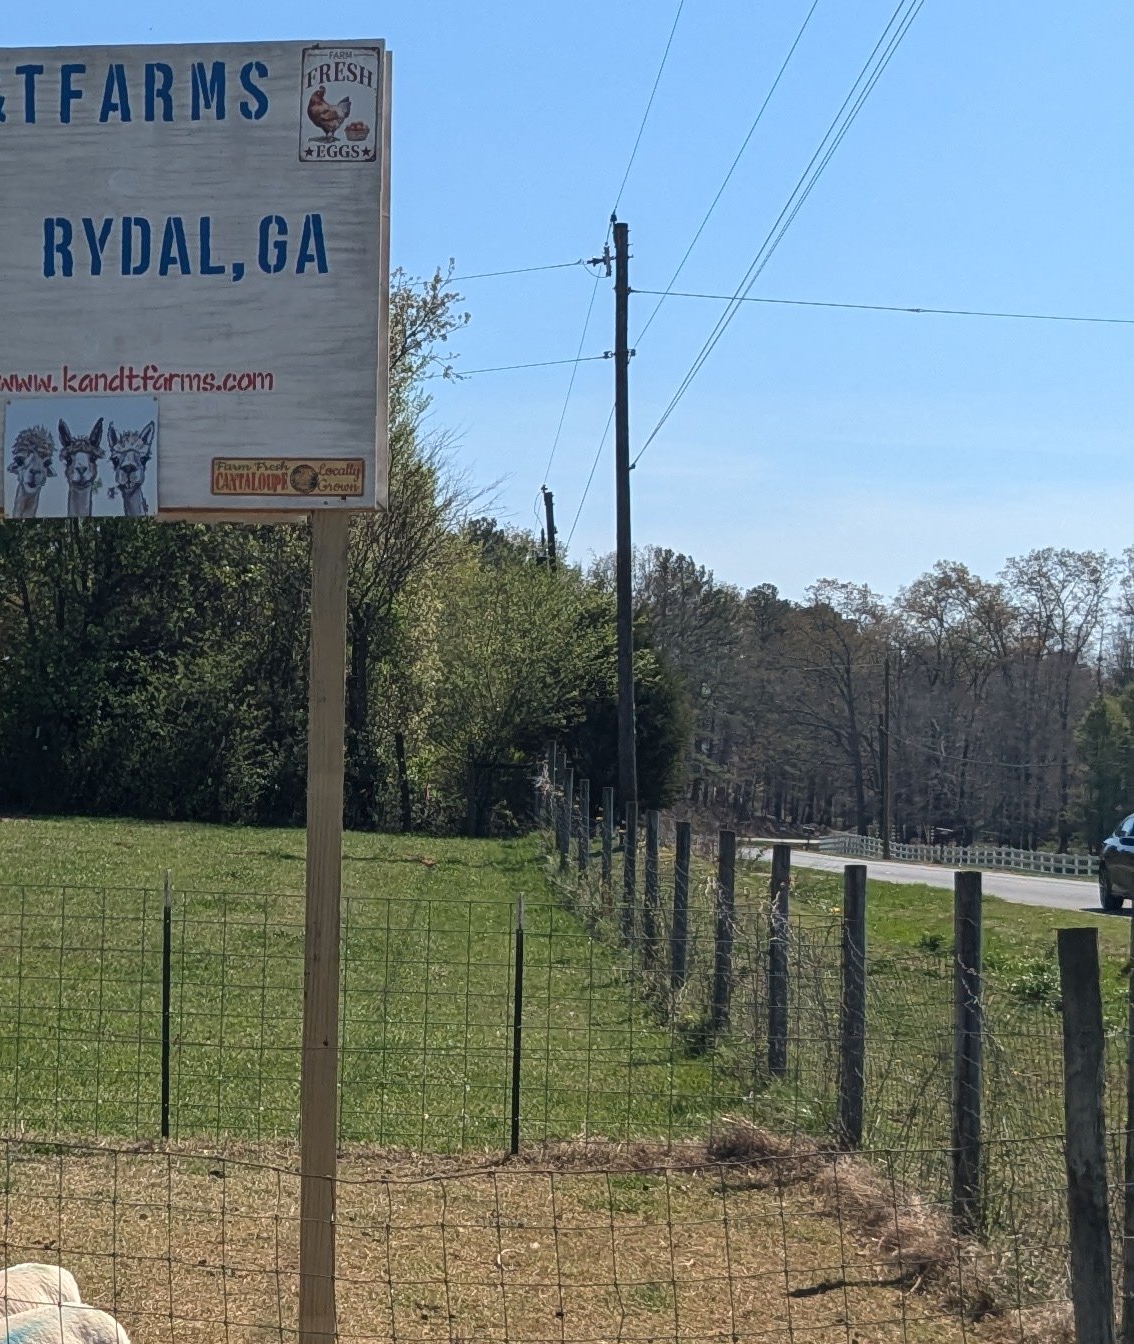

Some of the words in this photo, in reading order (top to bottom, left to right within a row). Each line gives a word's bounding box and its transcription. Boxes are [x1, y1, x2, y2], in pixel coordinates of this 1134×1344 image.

[329, 51, 353, 60] FARM
[306, 61, 373, 89] FRESH
[316, 144, 360, 158] EGGS
[215, 461, 251, 472] Farm
[255, 460, 290, 472] Fresh
[318, 463, 361, 482] Locally
[215, 472, 289, 492] CANTALOUPE
[318, 479, 358, 492] Grown
